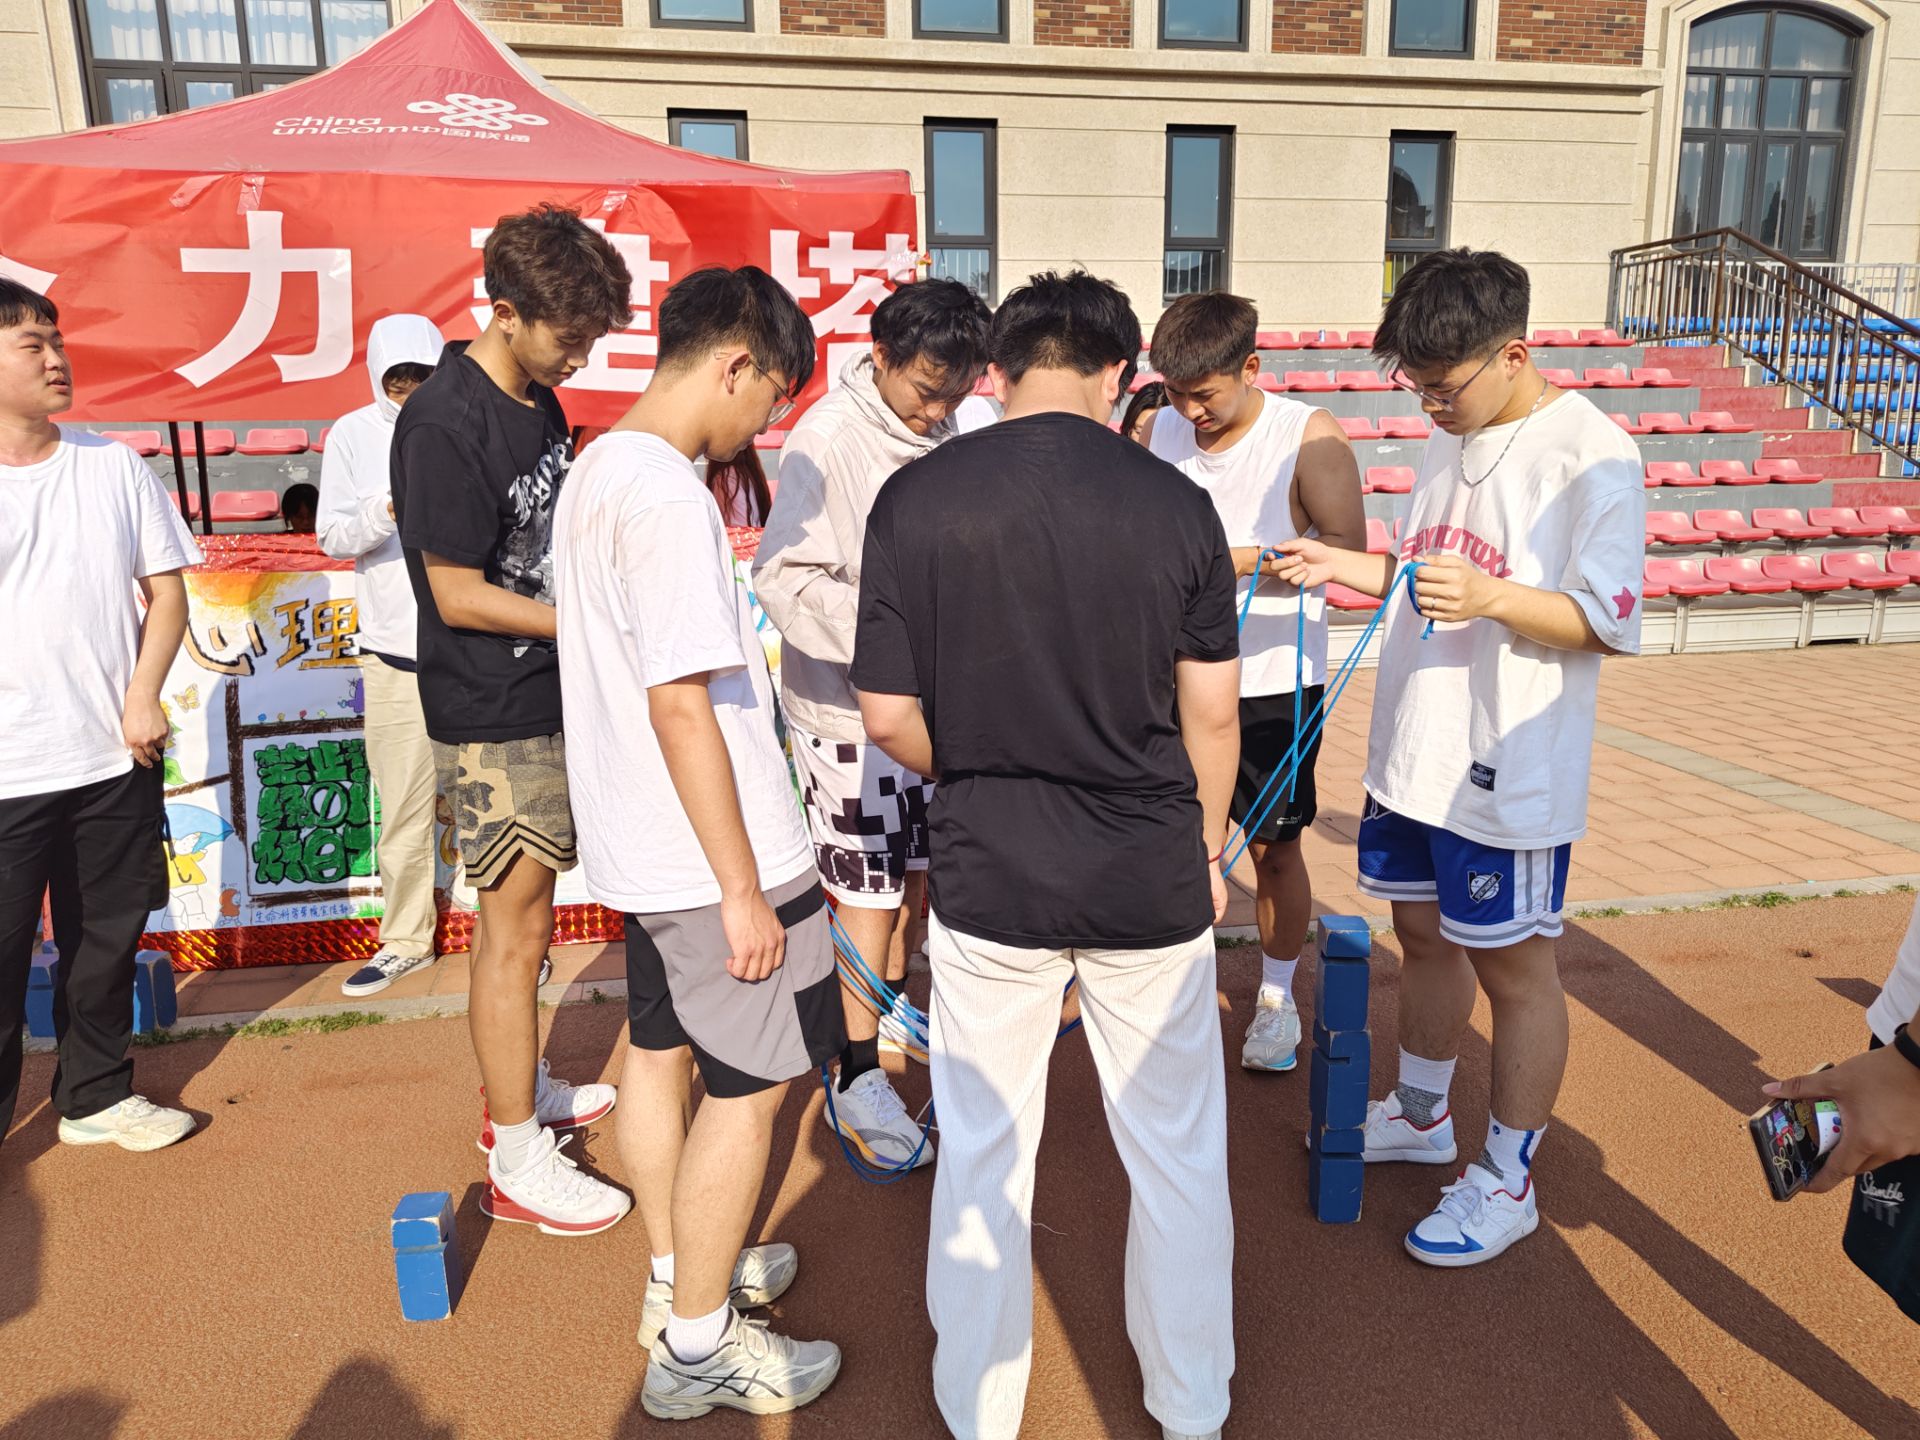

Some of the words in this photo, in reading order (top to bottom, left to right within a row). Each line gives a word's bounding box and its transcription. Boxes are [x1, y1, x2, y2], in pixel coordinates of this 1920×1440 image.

[275, 116, 382, 127] china
[272, 125, 409, 136] unicom
[411, 124, 531, 143] 中国联通
